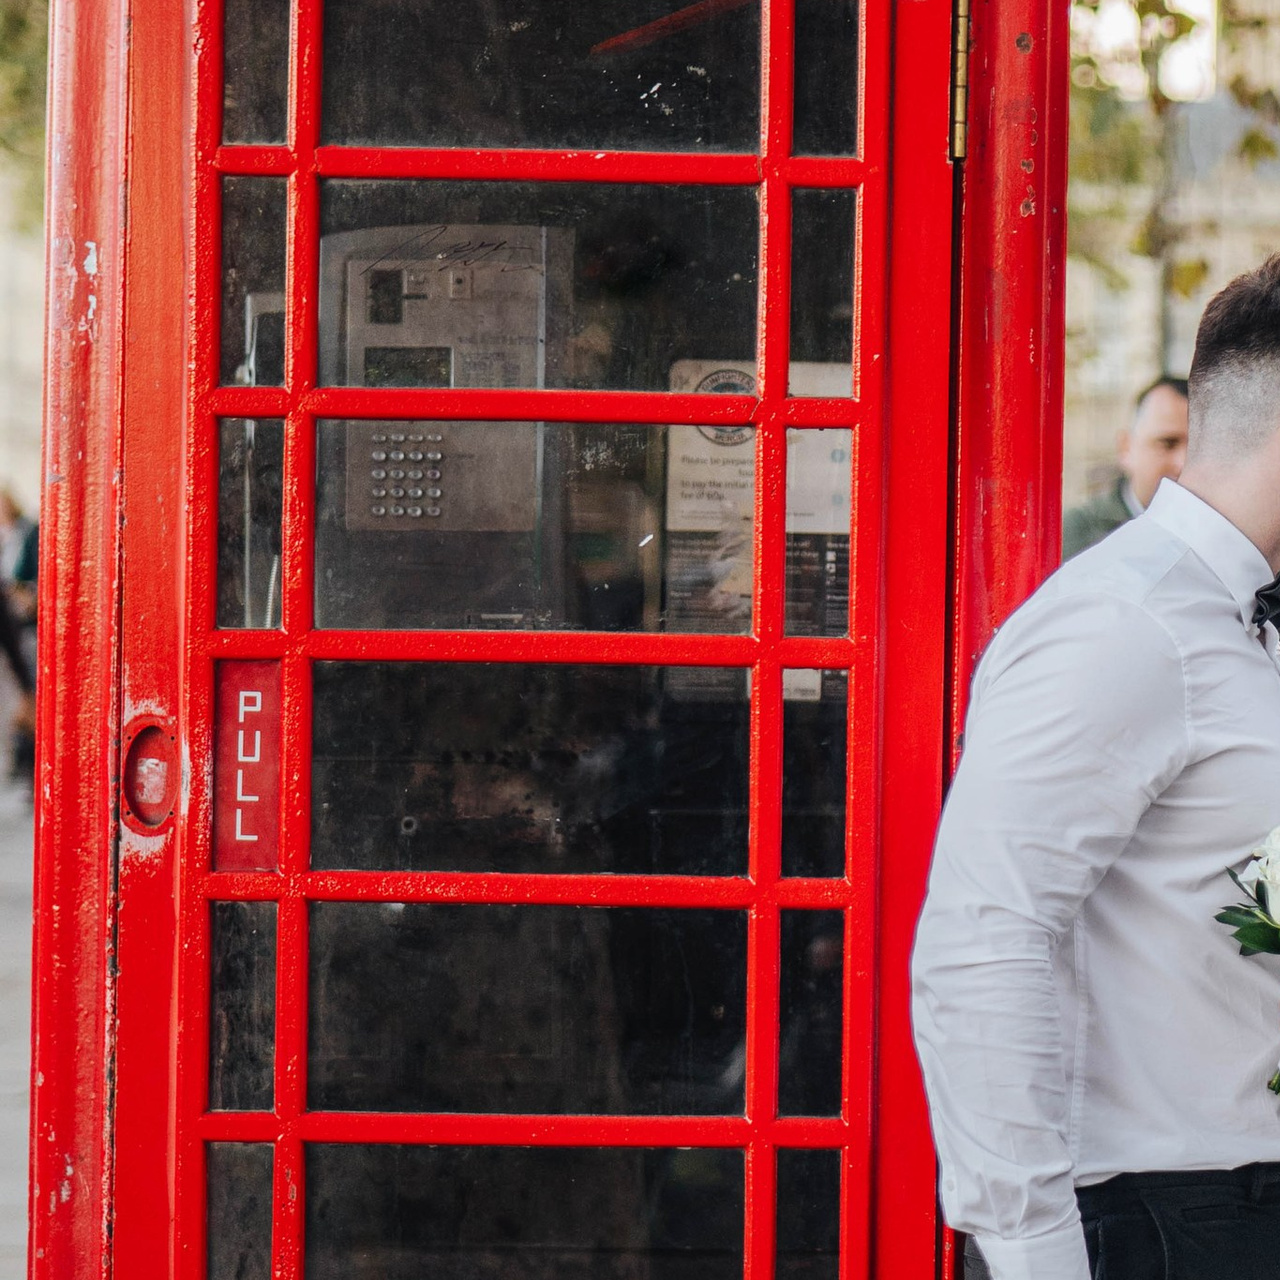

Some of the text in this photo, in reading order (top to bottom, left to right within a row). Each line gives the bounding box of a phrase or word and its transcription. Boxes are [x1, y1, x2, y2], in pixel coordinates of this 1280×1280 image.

[722, 458, 754, 467] prepare
[708, 480, 722, 488] the
[236, 691, 262, 841] PULL
